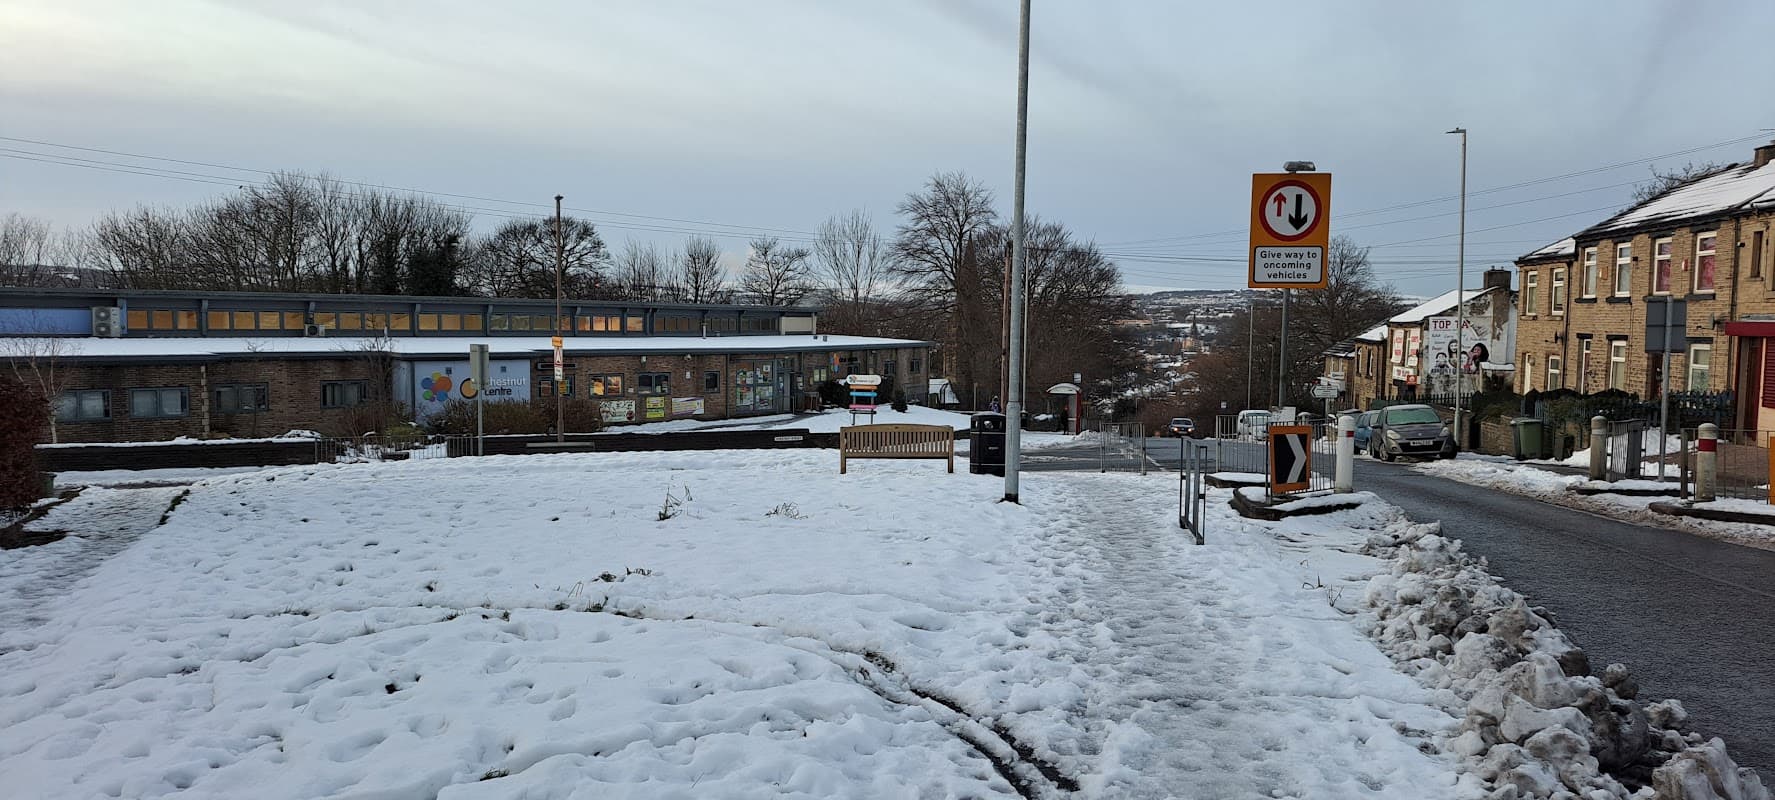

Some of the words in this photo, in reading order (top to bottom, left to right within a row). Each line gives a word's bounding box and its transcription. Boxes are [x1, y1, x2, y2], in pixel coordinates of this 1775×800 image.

[1260, 250, 1282, 259] Give
[1284, 252, 1304, 260] way
[1307, 251, 1318, 259] to
[1263, 260, 1312, 270] oncoming
[1267, 271, 1308, 279] vehicles
[1432, 320, 1451, 329] TOP
[487, 376, 526, 387] hestnut
